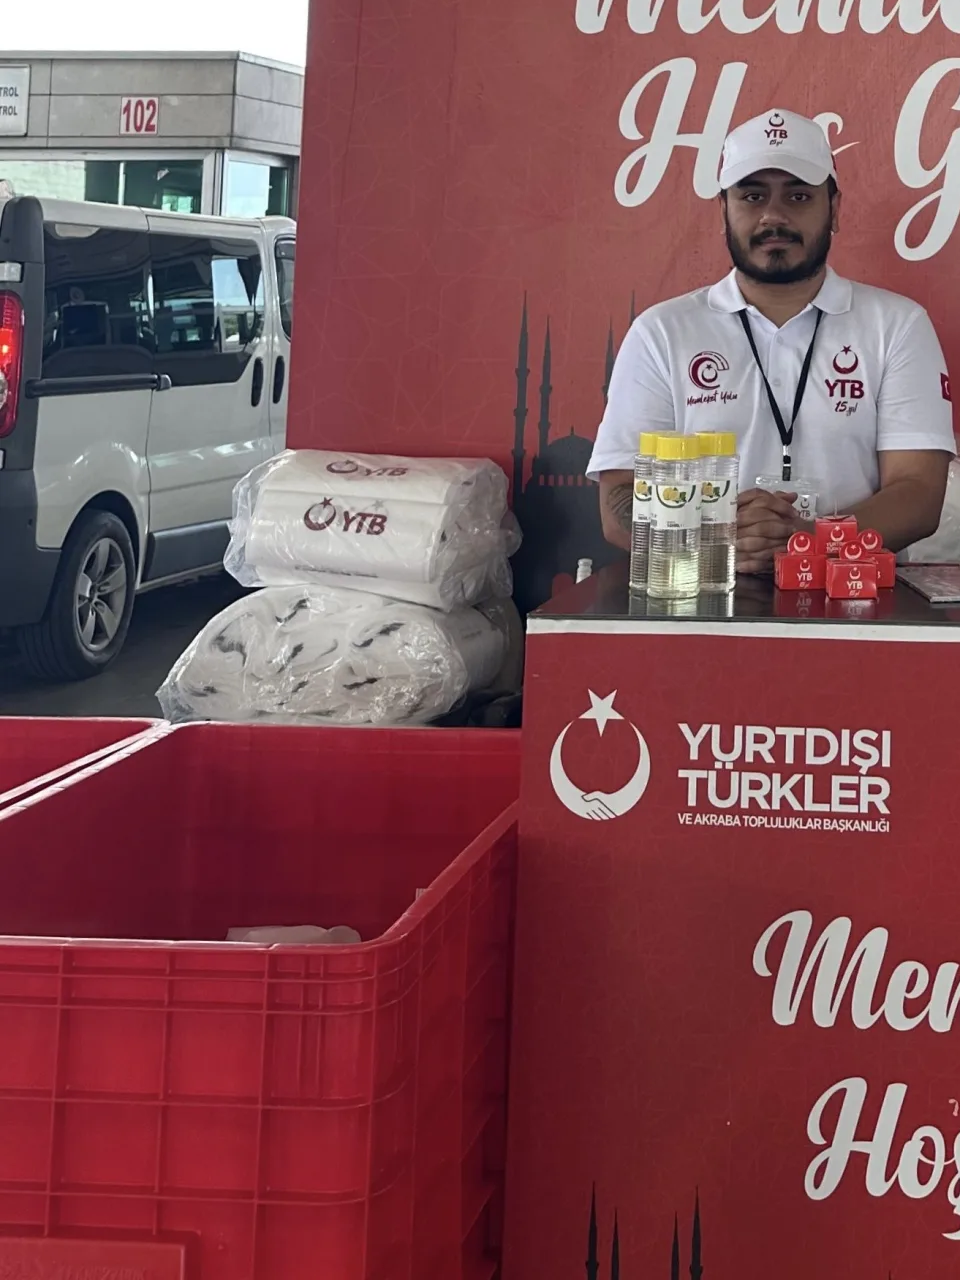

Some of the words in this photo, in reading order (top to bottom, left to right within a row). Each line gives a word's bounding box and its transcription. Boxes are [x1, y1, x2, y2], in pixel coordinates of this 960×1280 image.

[122, 99, 156, 133] 102
[763, 128, 788, 139] YTB
[824, 378, 864, 399] YTB
[343, 510, 388, 536] YTB
[796, 572, 813, 581] YTB
[846, 580, 863, 590] YTB
[678, 723, 891, 775] YURTDIŞI
[678, 761, 891, 815] TÜRKLER
[677, 812, 693, 825] VE
[693, 813, 741, 828] AKRABA
[742, 815, 822, 830] TOPLULUKLAR
[823, 817, 890, 833] BAŞKANLIĞI
